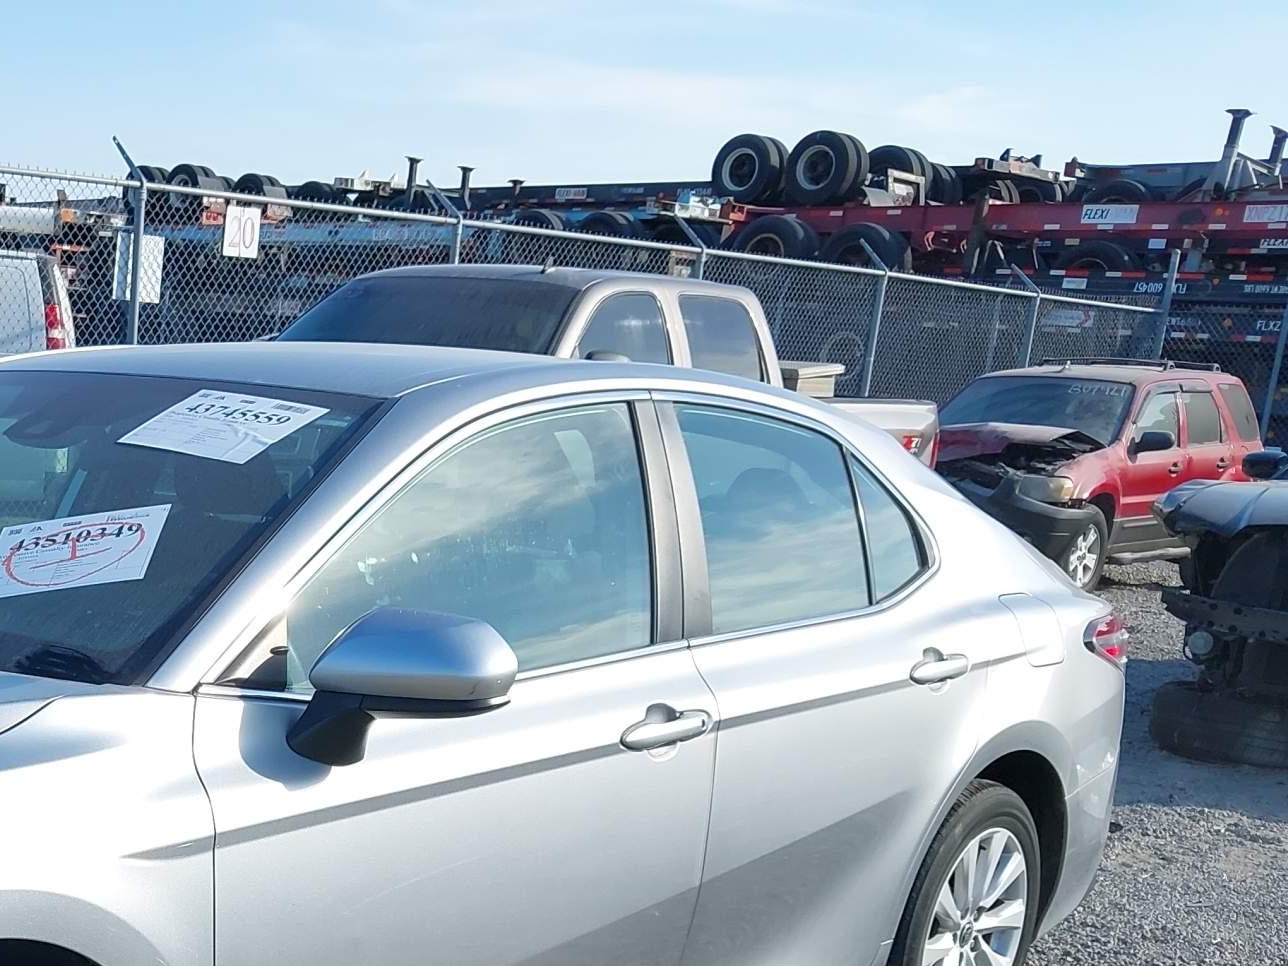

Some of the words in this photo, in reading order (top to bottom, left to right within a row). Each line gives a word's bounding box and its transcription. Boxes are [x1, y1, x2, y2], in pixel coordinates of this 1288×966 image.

[1083, 208, 1111, 220] FLEXI
[228, 216, 255, 250] 20
[185, 402, 292, 426] 43745559
[9, 523, 143, 552] 43510349
